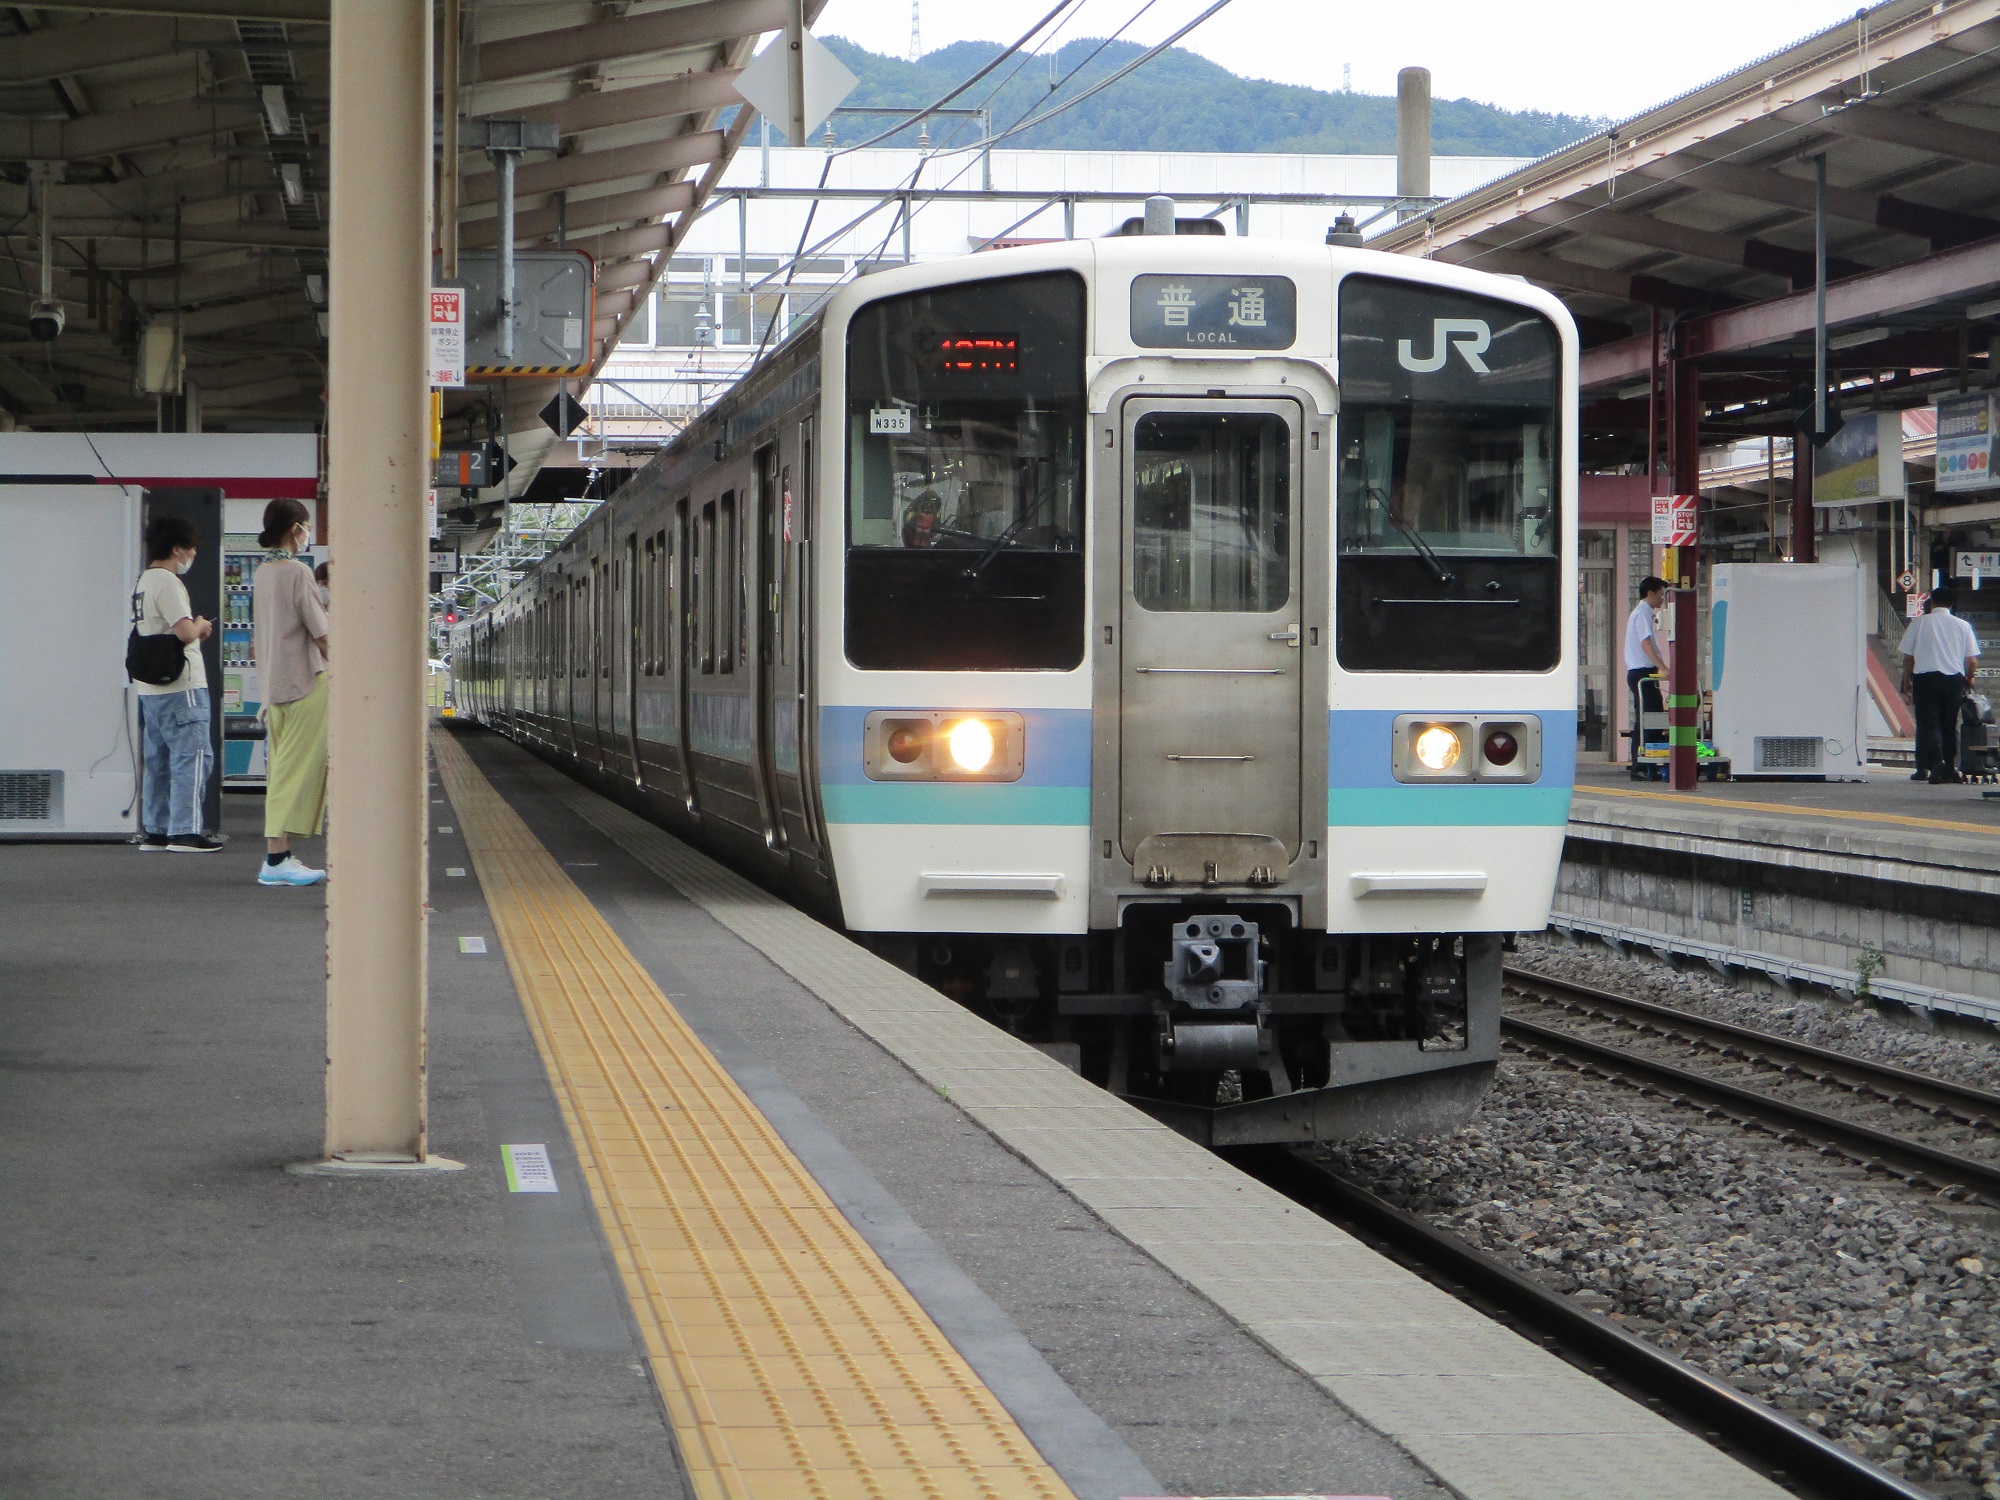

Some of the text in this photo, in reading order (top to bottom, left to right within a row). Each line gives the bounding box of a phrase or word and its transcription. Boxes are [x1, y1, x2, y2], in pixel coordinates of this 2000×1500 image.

[432, 294, 458, 303] STOP
[1157, 283, 1267, 326] 普通
[431, 327, 459, 337] 非常停止
[1186, 332, 1237, 343] LOCAL
[437, 338, 459, 346] ボタン
[1398, 318, 1491, 373] JR
[875, 417, 905, 429] N335
[470, 452, 482, 470] 2
[1903, 575, 1912, 587] 8
